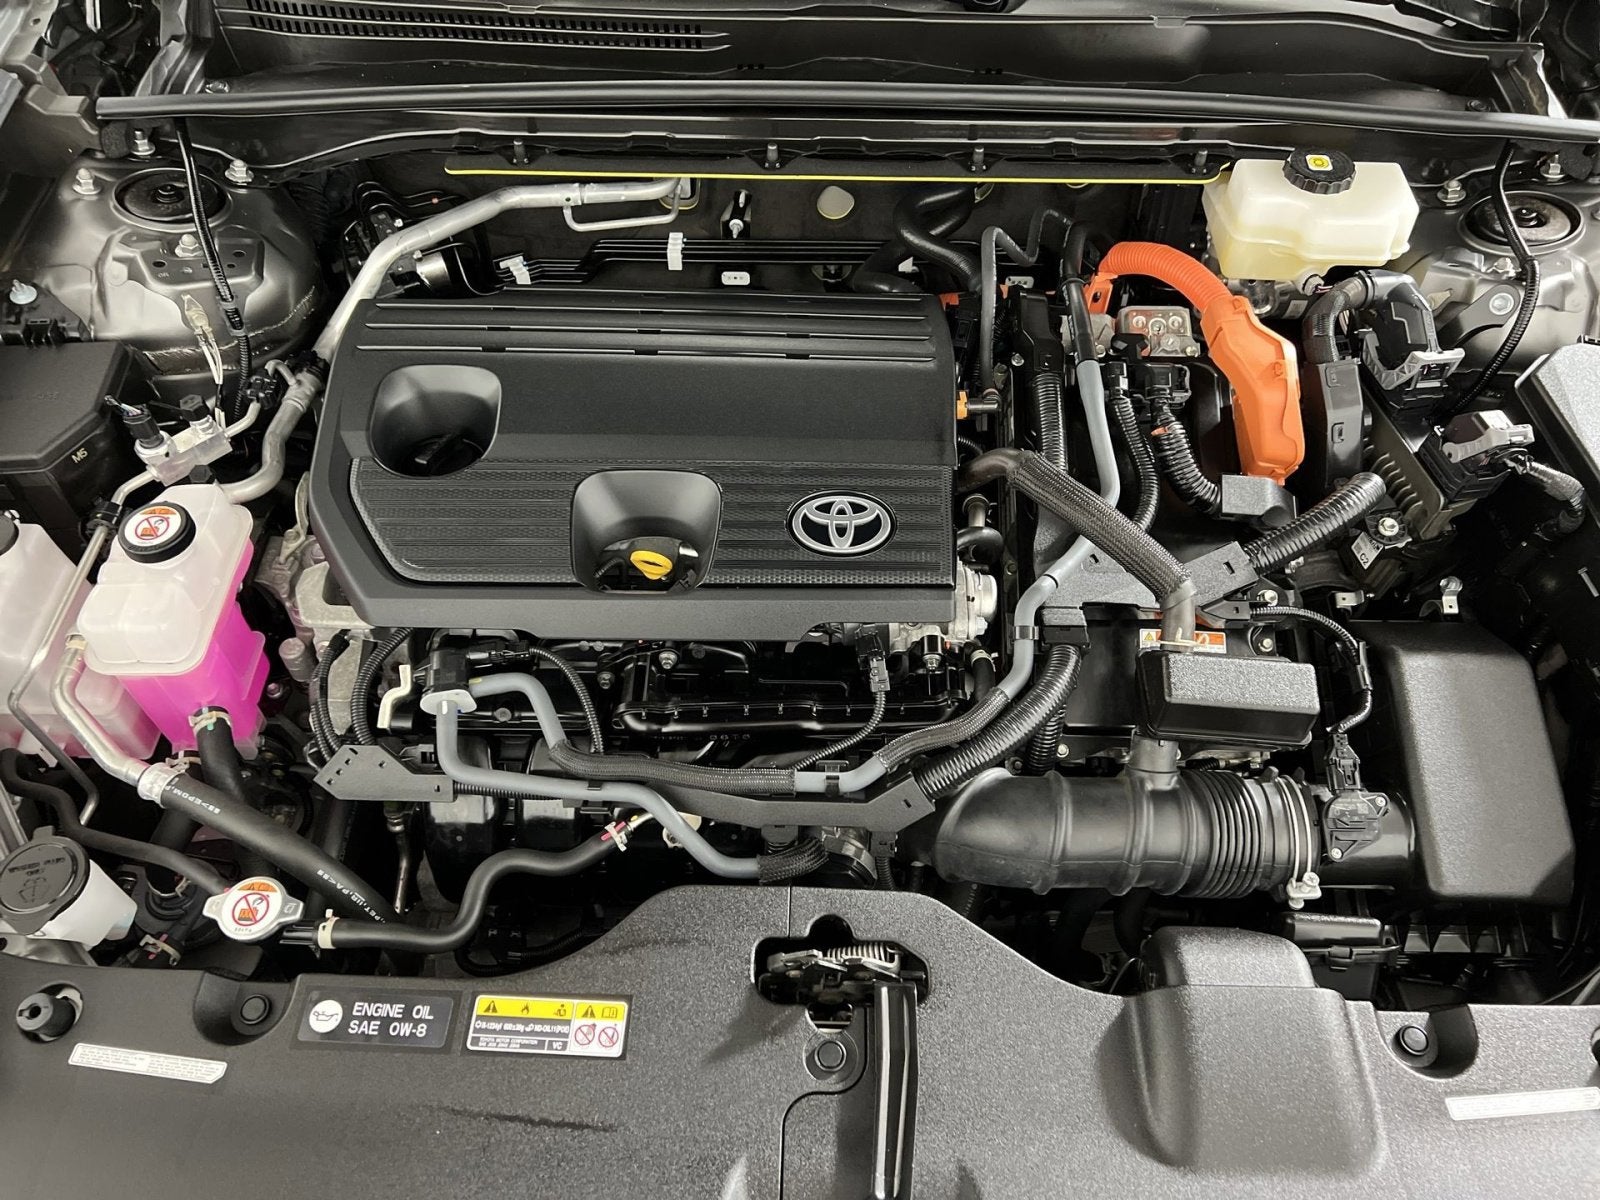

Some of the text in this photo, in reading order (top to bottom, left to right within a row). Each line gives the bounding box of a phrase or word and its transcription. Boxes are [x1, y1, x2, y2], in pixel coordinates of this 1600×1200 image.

[352, 1001, 434, 1020] ENGINE OIL
[348, 1020, 427, 1038] SAE 0W-8
